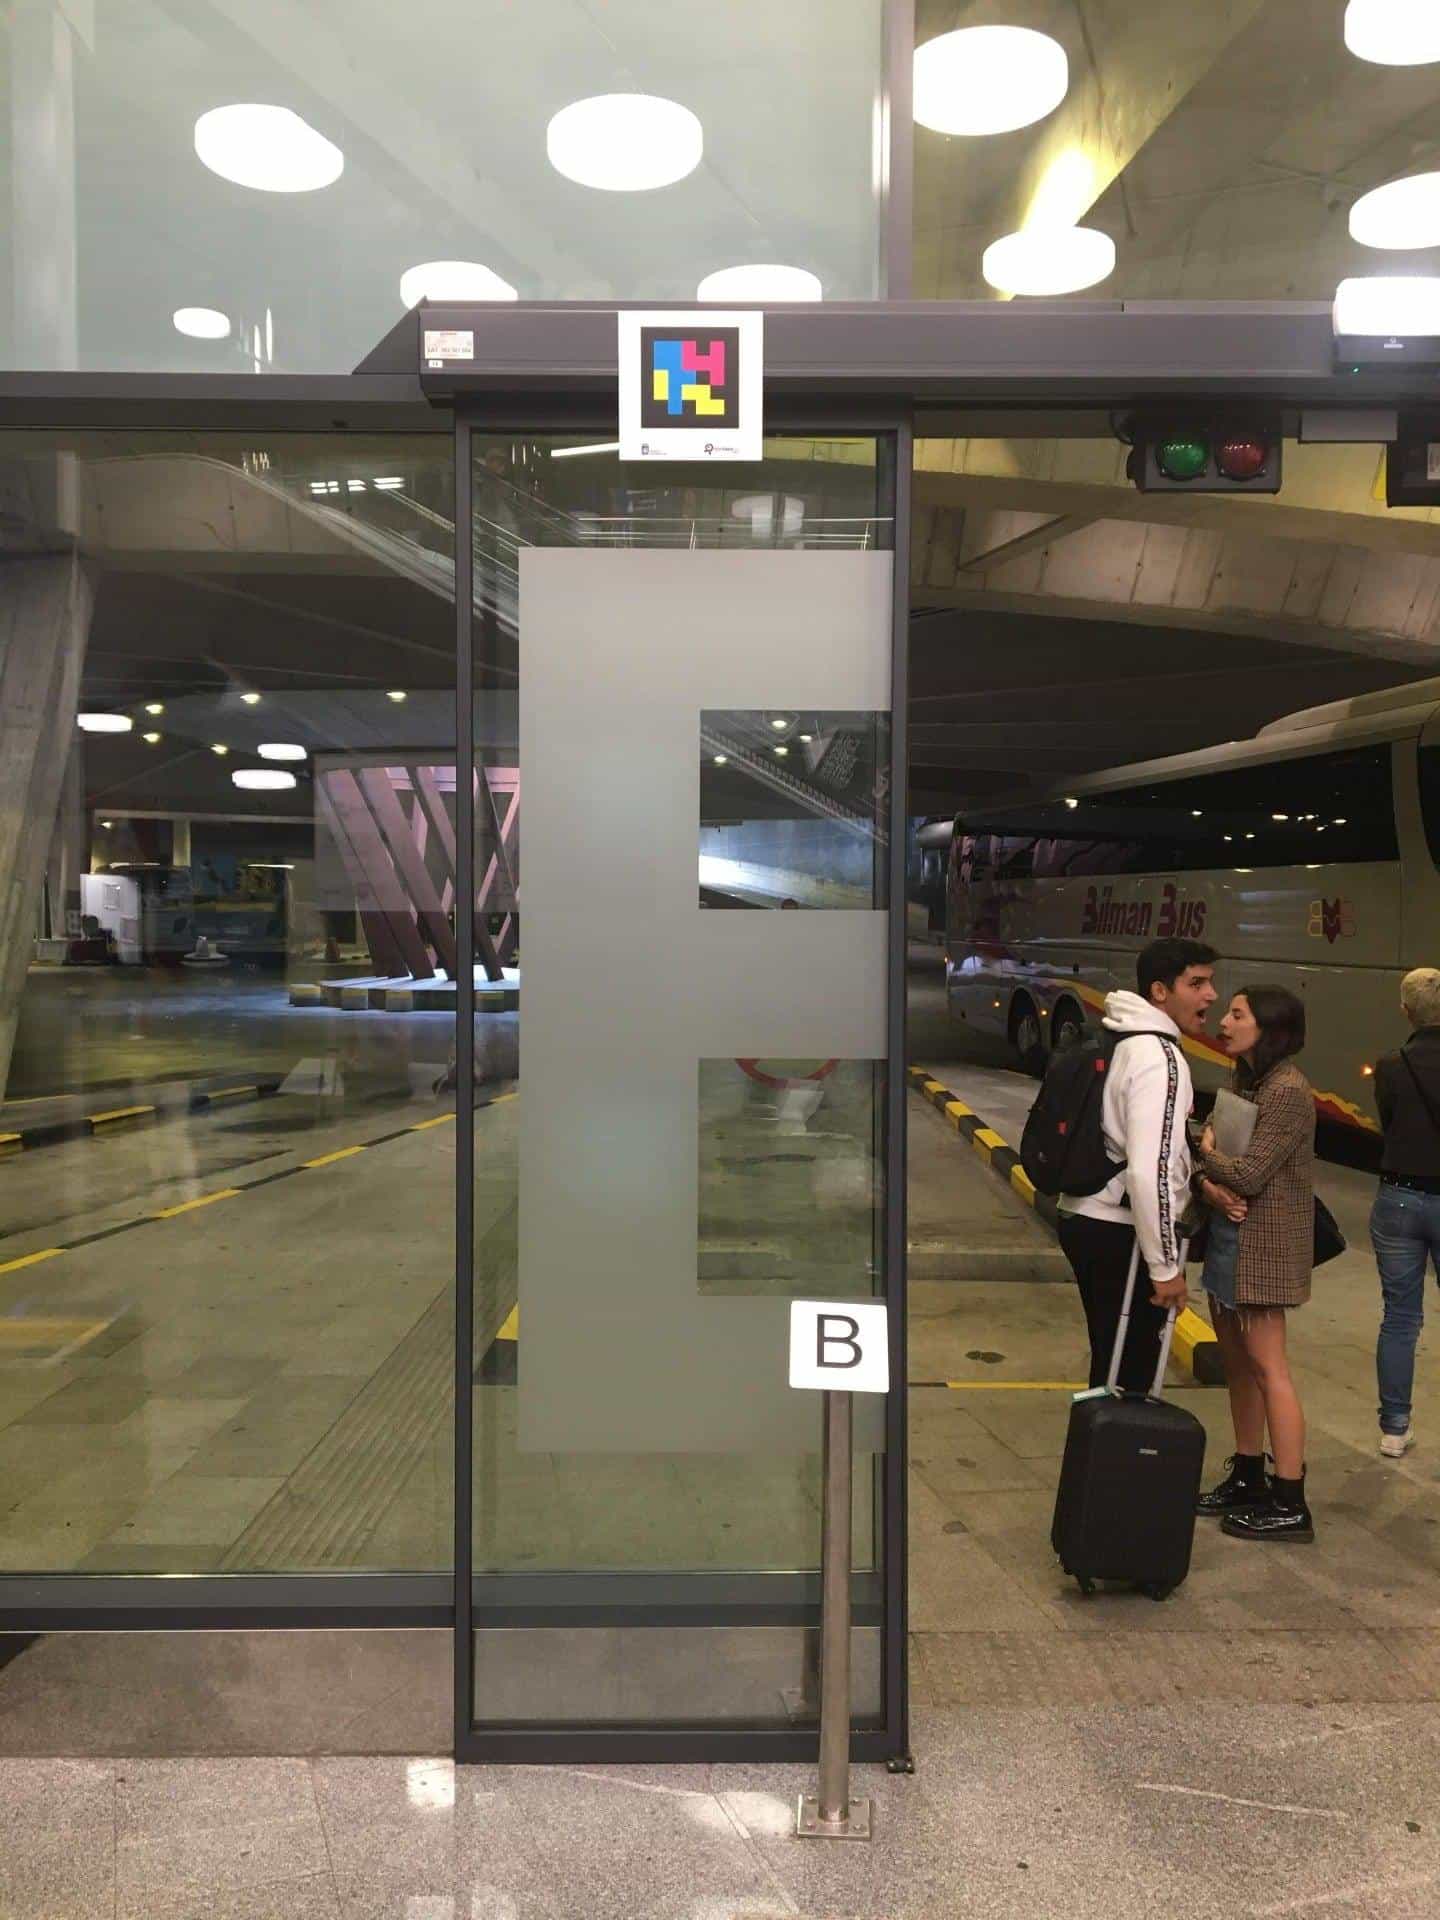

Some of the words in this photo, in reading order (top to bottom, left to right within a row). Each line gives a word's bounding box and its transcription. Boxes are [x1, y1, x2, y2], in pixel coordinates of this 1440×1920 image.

[1081, 886, 1153, 936] Bilman
[1157, 883, 1207, 937] Bus
[816, 1314, 863, 1369] B
